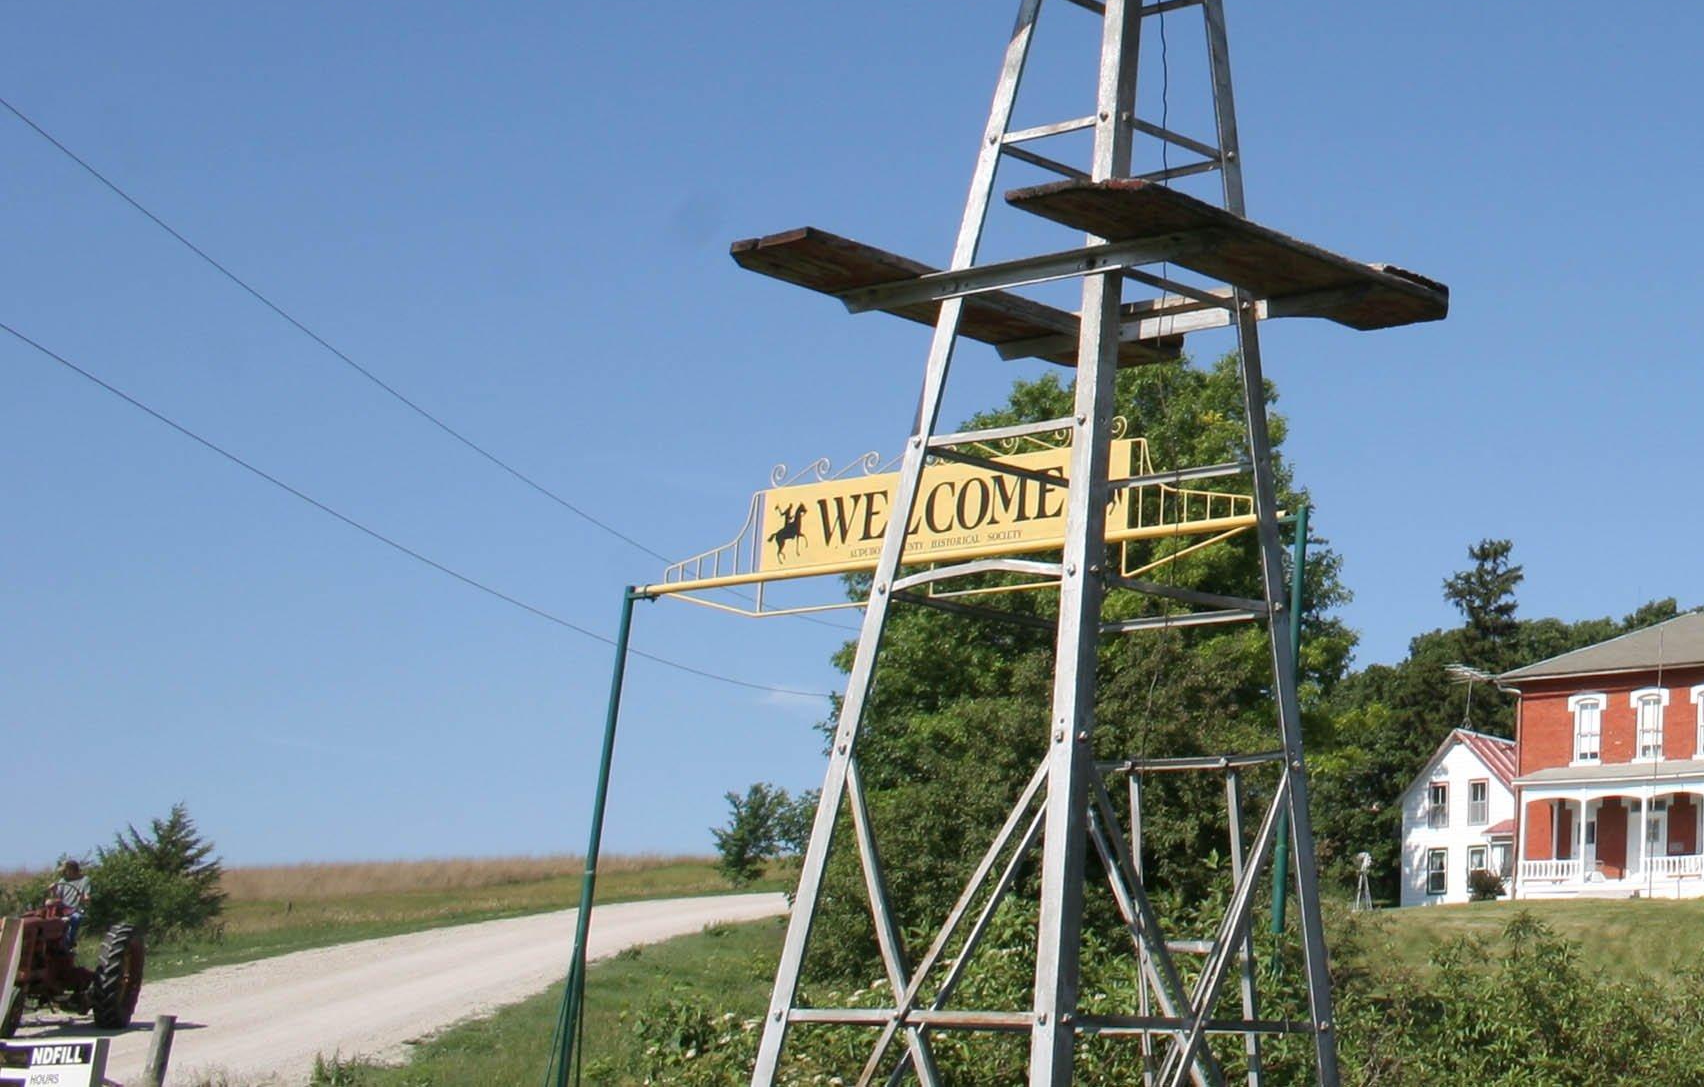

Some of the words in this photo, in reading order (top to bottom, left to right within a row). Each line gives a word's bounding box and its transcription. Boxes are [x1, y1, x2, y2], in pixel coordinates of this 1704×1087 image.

[931, 534, 980, 549] HISTORICAL
[987, 529, 1024, 540] SOCIETY
[32, 1045, 82, 1065] NDFILL
[30, 1074, 59, 1085] HOURS
